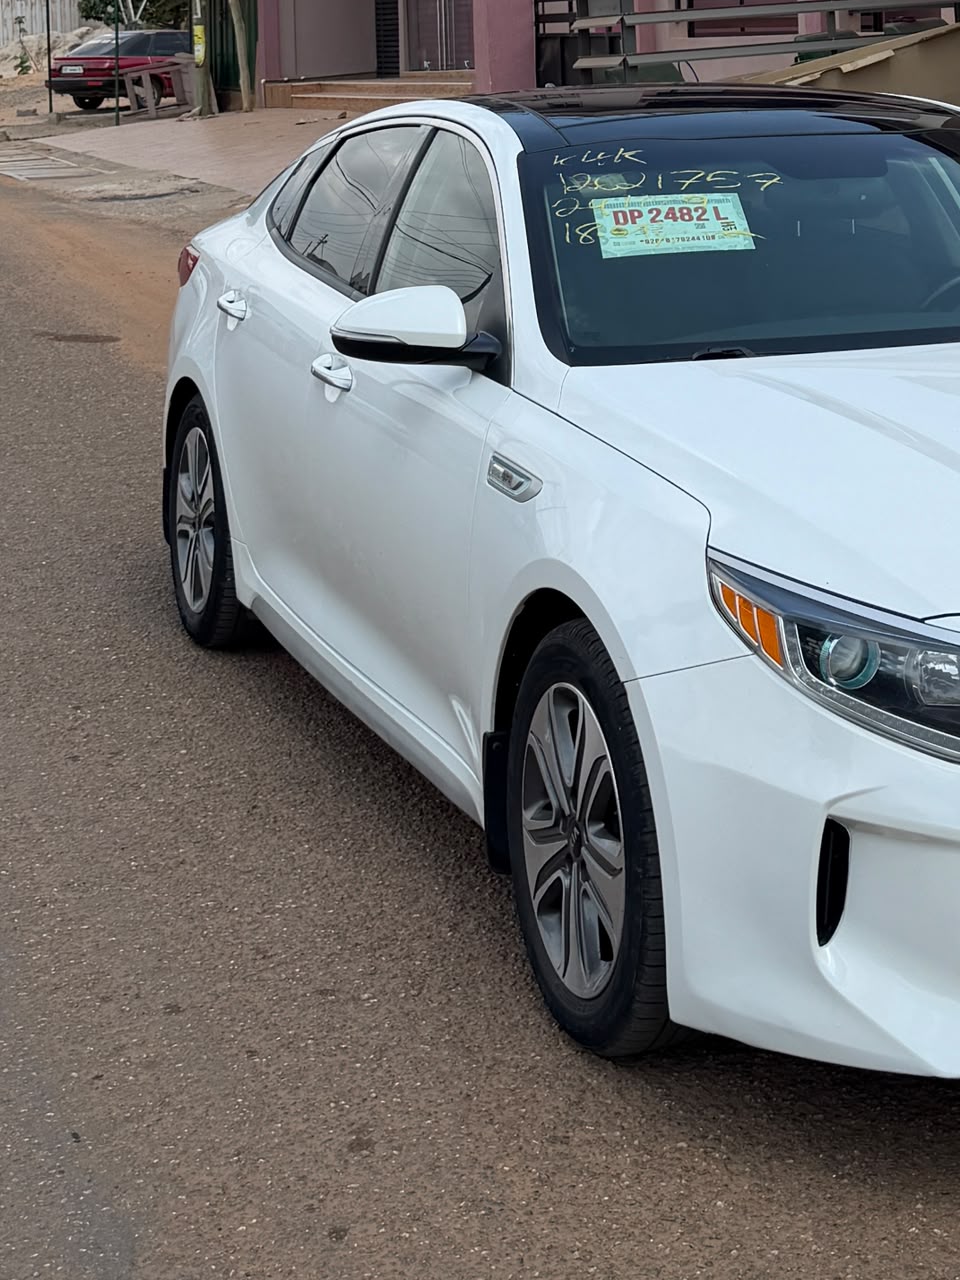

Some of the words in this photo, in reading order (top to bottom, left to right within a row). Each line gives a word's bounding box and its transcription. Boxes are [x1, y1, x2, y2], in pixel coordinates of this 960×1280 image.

[612, 208, 643, 226] DP
[647, 206, 710, 224] 2482
[712, 205, 729, 221] L
